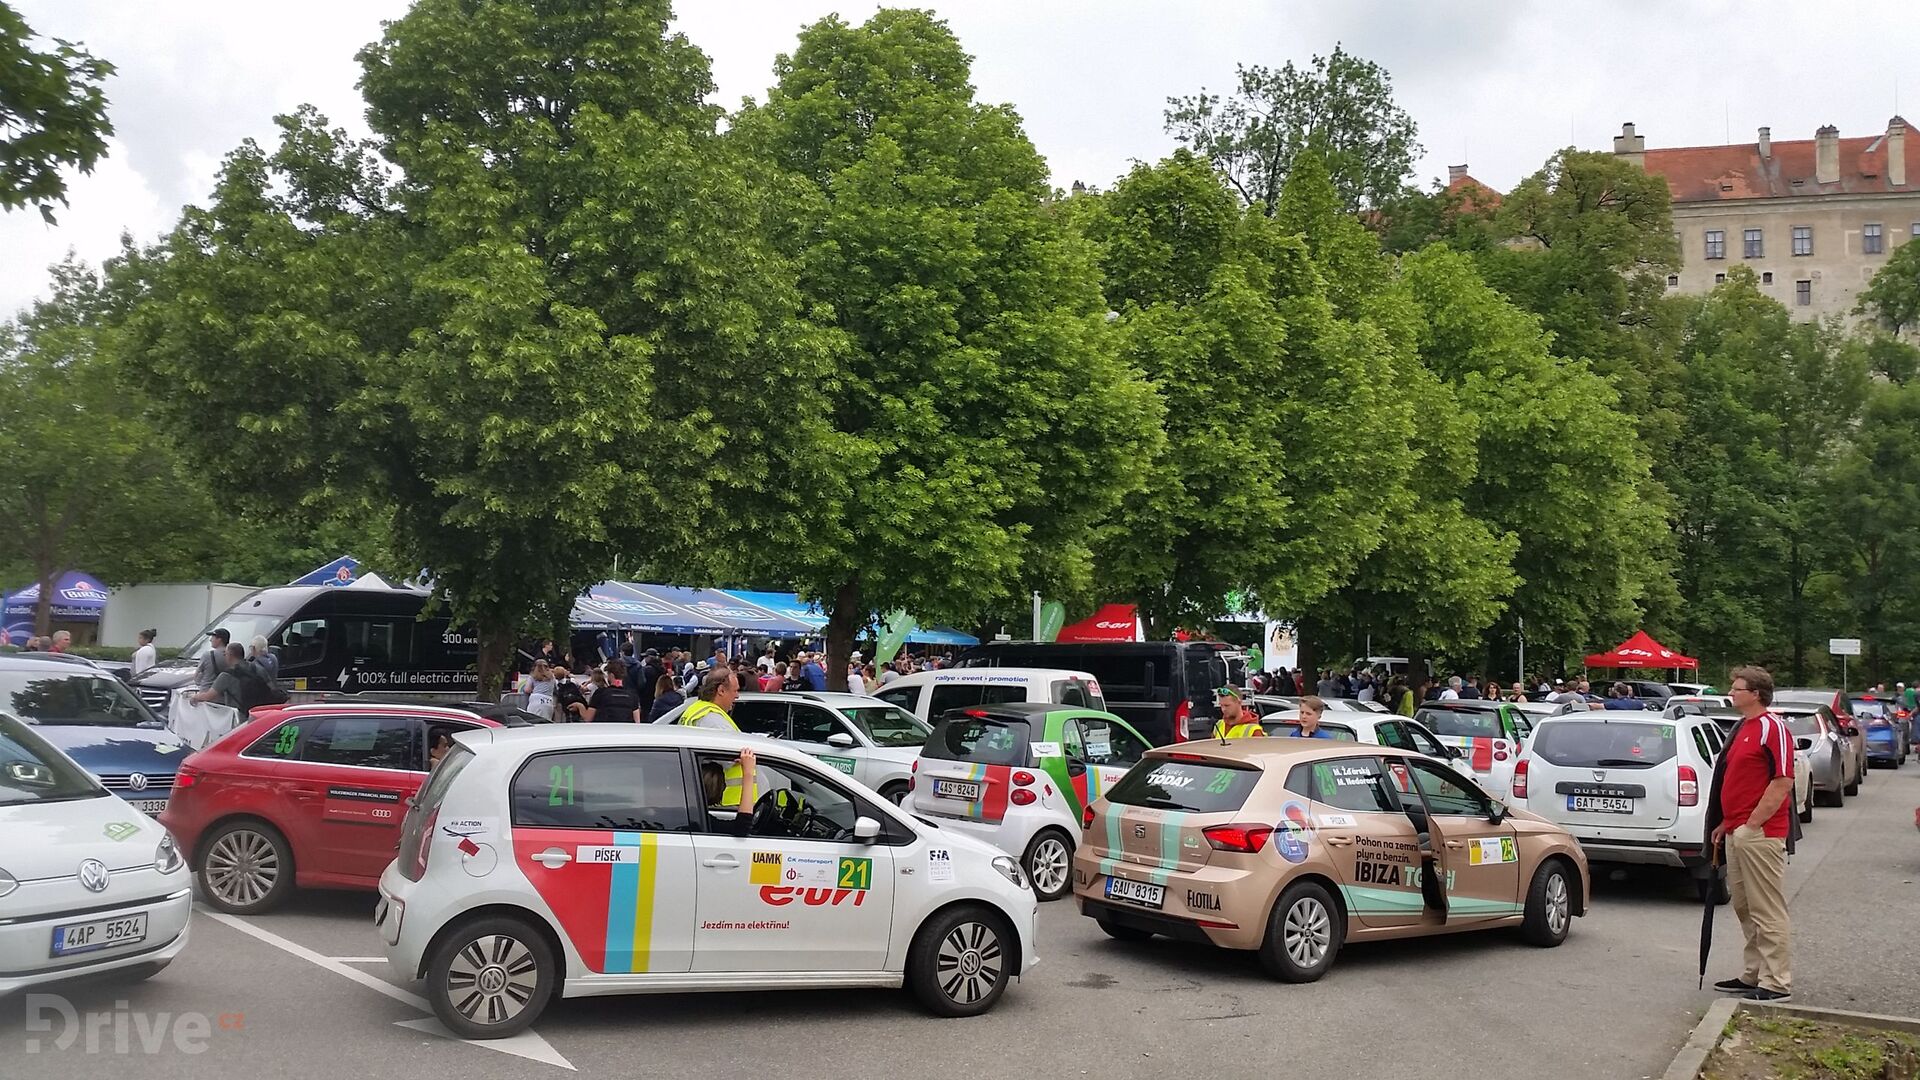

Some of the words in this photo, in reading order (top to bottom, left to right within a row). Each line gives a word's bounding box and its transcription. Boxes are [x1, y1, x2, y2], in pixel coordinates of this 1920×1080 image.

[442, 633, 462, 644] 300
[356, 672, 387, 684] 100%
[390, 671, 407, 684] full
[410, 671, 450, 684] electric
[988, 675, 1029, 683] promotion
[274, 725, 300, 754] 33
[548, 764, 574, 806] 21
[939, 780, 953, 794] 4AS
[1146, 774, 1194, 787] TODAY
[1204, 770, 1237, 794] 25
[1573, 788, 1625, 796] DUSTER
[142, 801, 166, 811] 3338
[1576, 798, 1594, 808] 6AT
[1603, 799, 1628, 810] 5454
[1355, 835, 1382, 848] Pohon
[1384, 841, 1394, 849] na
[594, 847, 622, 862] PÍSEK
[1356, 848, 1374, 861] plyn
[1502, 839, 1514, 861] 25
[753, 852, 782, 865] UAMK
[839, 860, 868, 888] 21
[1355, 861, 1400, 886] IBIZA
[1112, 879, 1130, 896] 6AU
[1135, 884, 1159, 902] 8315
[1187, 889, 1222, 911] FLOTILA
[67, 926, 95, 946] 4AP
[106, 918, 140, 940] 5524
[701, 920, 732, 930] Jezdím
[734, 922, 745, 930] na
[747, 920, 790, 930] elektřinu!
